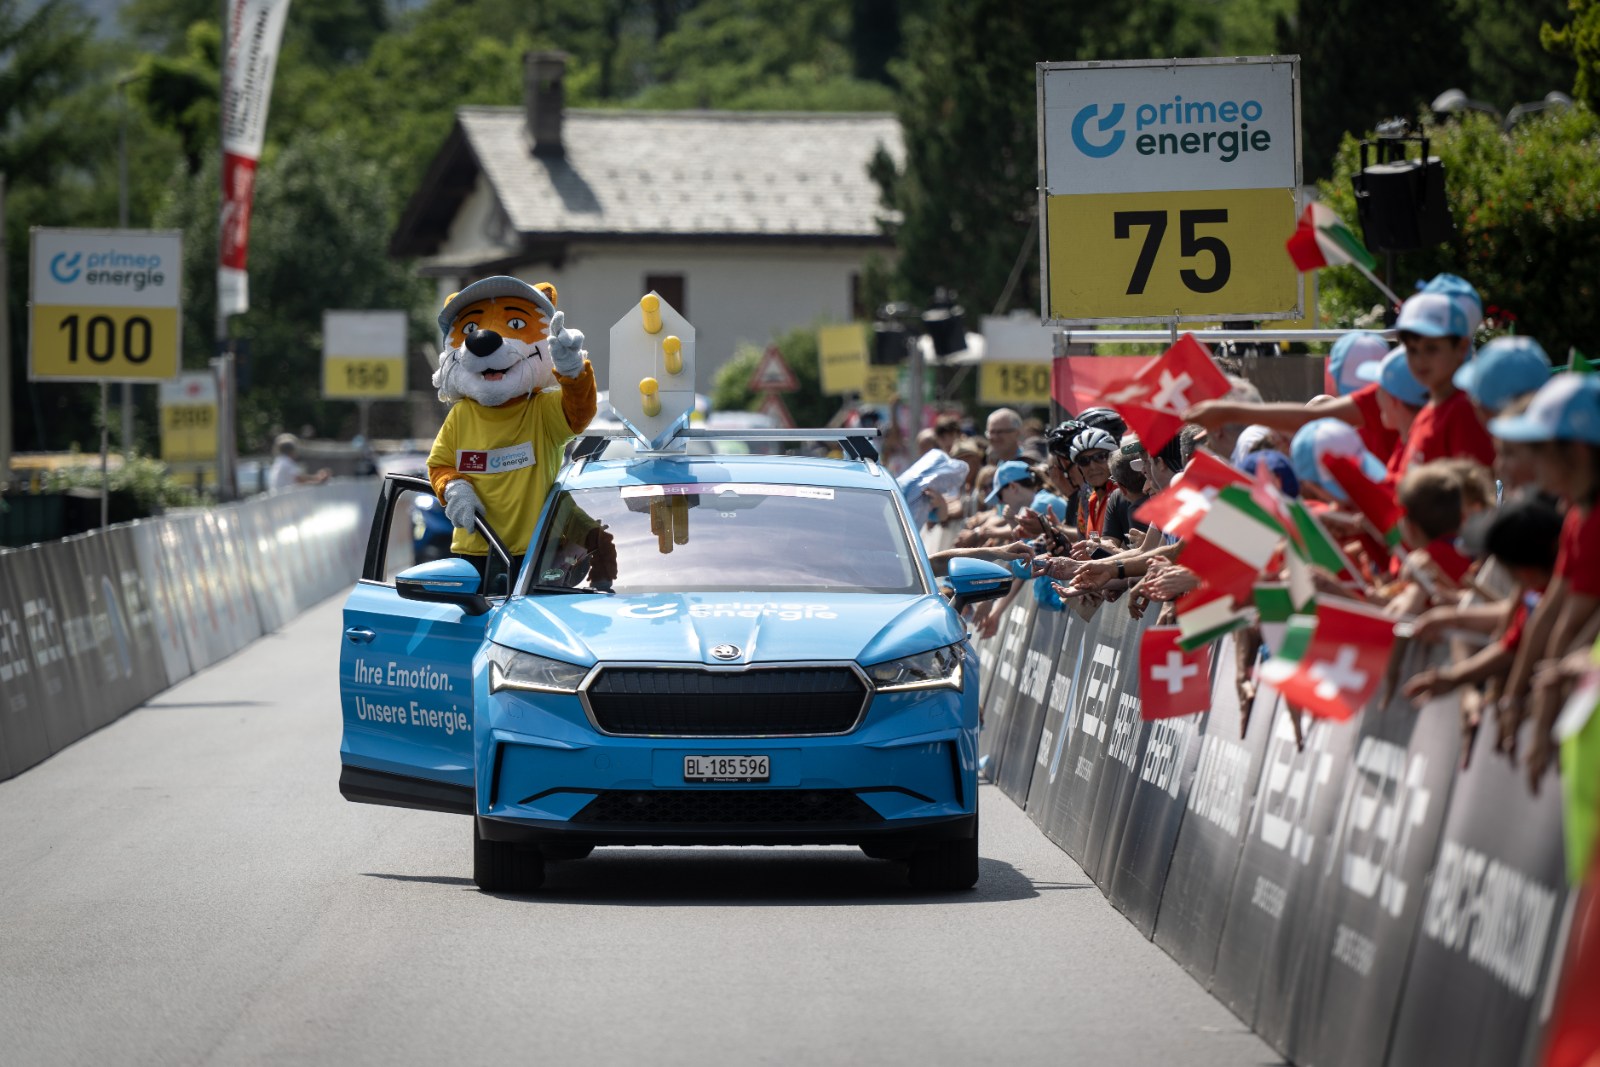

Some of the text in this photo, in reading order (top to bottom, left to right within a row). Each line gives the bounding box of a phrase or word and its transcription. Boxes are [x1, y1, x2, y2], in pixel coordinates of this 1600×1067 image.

[1136, 95, 1263, 131] primeo
[1136, 122, 1271, 163] energie
[86, 250, 161, 268] primeo
[1113, 208, 1232, 295] 75
[86, 269, 165, 292] energie
[59, 313, 153, 365] 100
[996, 366, 1049, 394] 150
[503, 457, 528, 467] energie
[354, 659, 453, 691] Ihre Emotion.
[355, 695, 472, 735] Unsere Energie.
